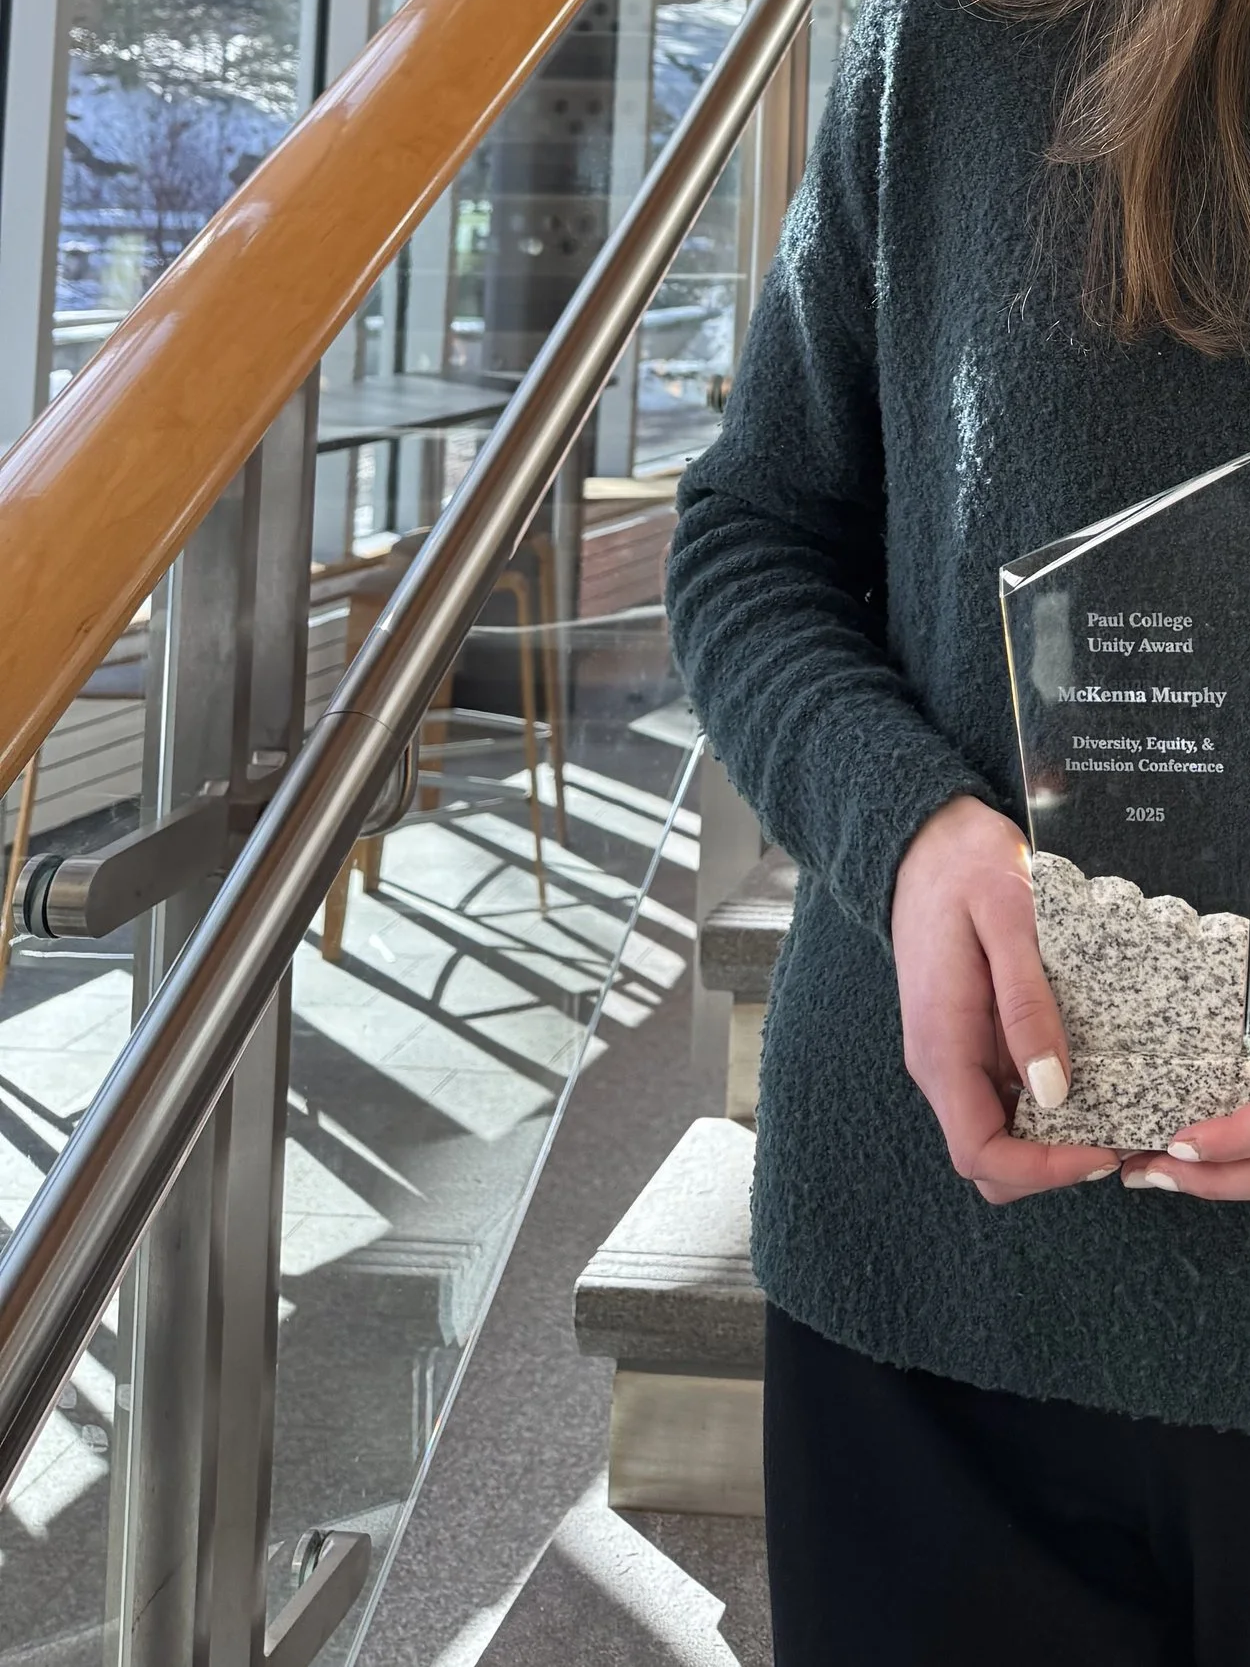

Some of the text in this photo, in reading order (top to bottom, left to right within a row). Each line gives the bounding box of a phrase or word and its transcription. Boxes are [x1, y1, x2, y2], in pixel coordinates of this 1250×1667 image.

[1086, 612, 1193, 631] Paul College
[1087, 637, 1194, 656] Unity Award
[1058, 686, 1227, 708] McKenna Murphy
[1072, 736, 1215, 754] Diversity, Equity, &
[1064, 758, 1224, 773] Inclusion Conference
[1125, 807, 1165, 822] 2025
